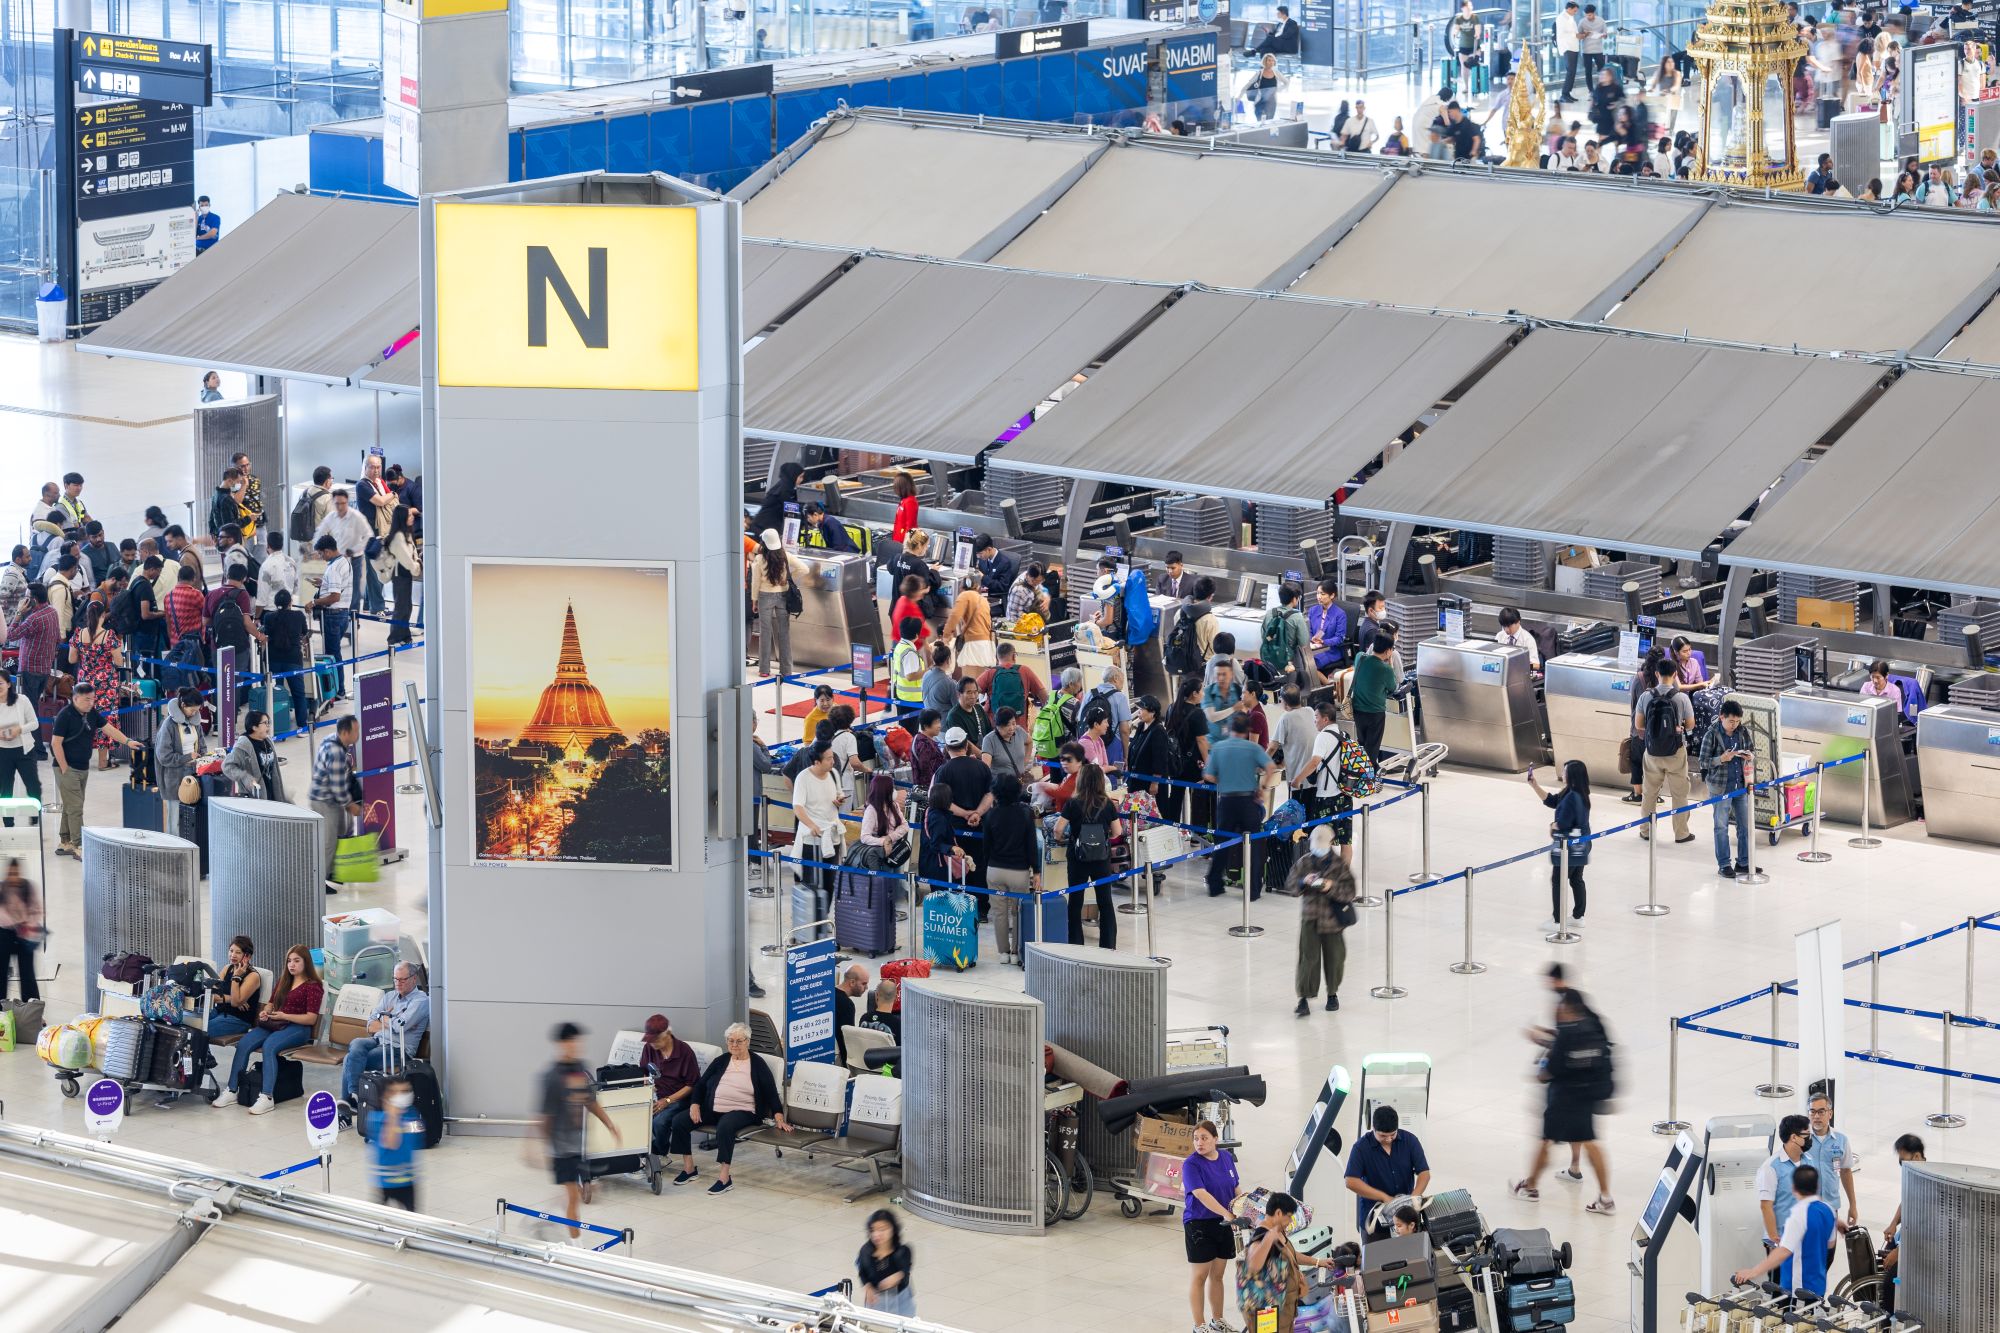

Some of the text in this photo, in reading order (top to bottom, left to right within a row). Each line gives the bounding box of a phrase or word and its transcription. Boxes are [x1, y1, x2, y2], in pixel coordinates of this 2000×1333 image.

[115, 51, 134, 60] Check-in
[183, 50, 200, 64] A-K
[170, 123, 187, 134] M-W
[526, 245, 609, 349] N
[1106, 503, 1131, 515] HANDLING
[1662, 599, 1684, 611] BAGGAGE
[373, 701, 388, 709] INDIA
[366, 731, 389, 741] BUSINESS
[929, 910, 963, 927] Enjoy
[924, 922, 968, 937] SUMMER
[790, 969, 833, 985] CARRY-ON BAGGAGE
[810, 980, 823, 989] GUIDE
[805, 1032, 815, 1040] 15.7
[1063, 1140, 1069, 1149] 2
